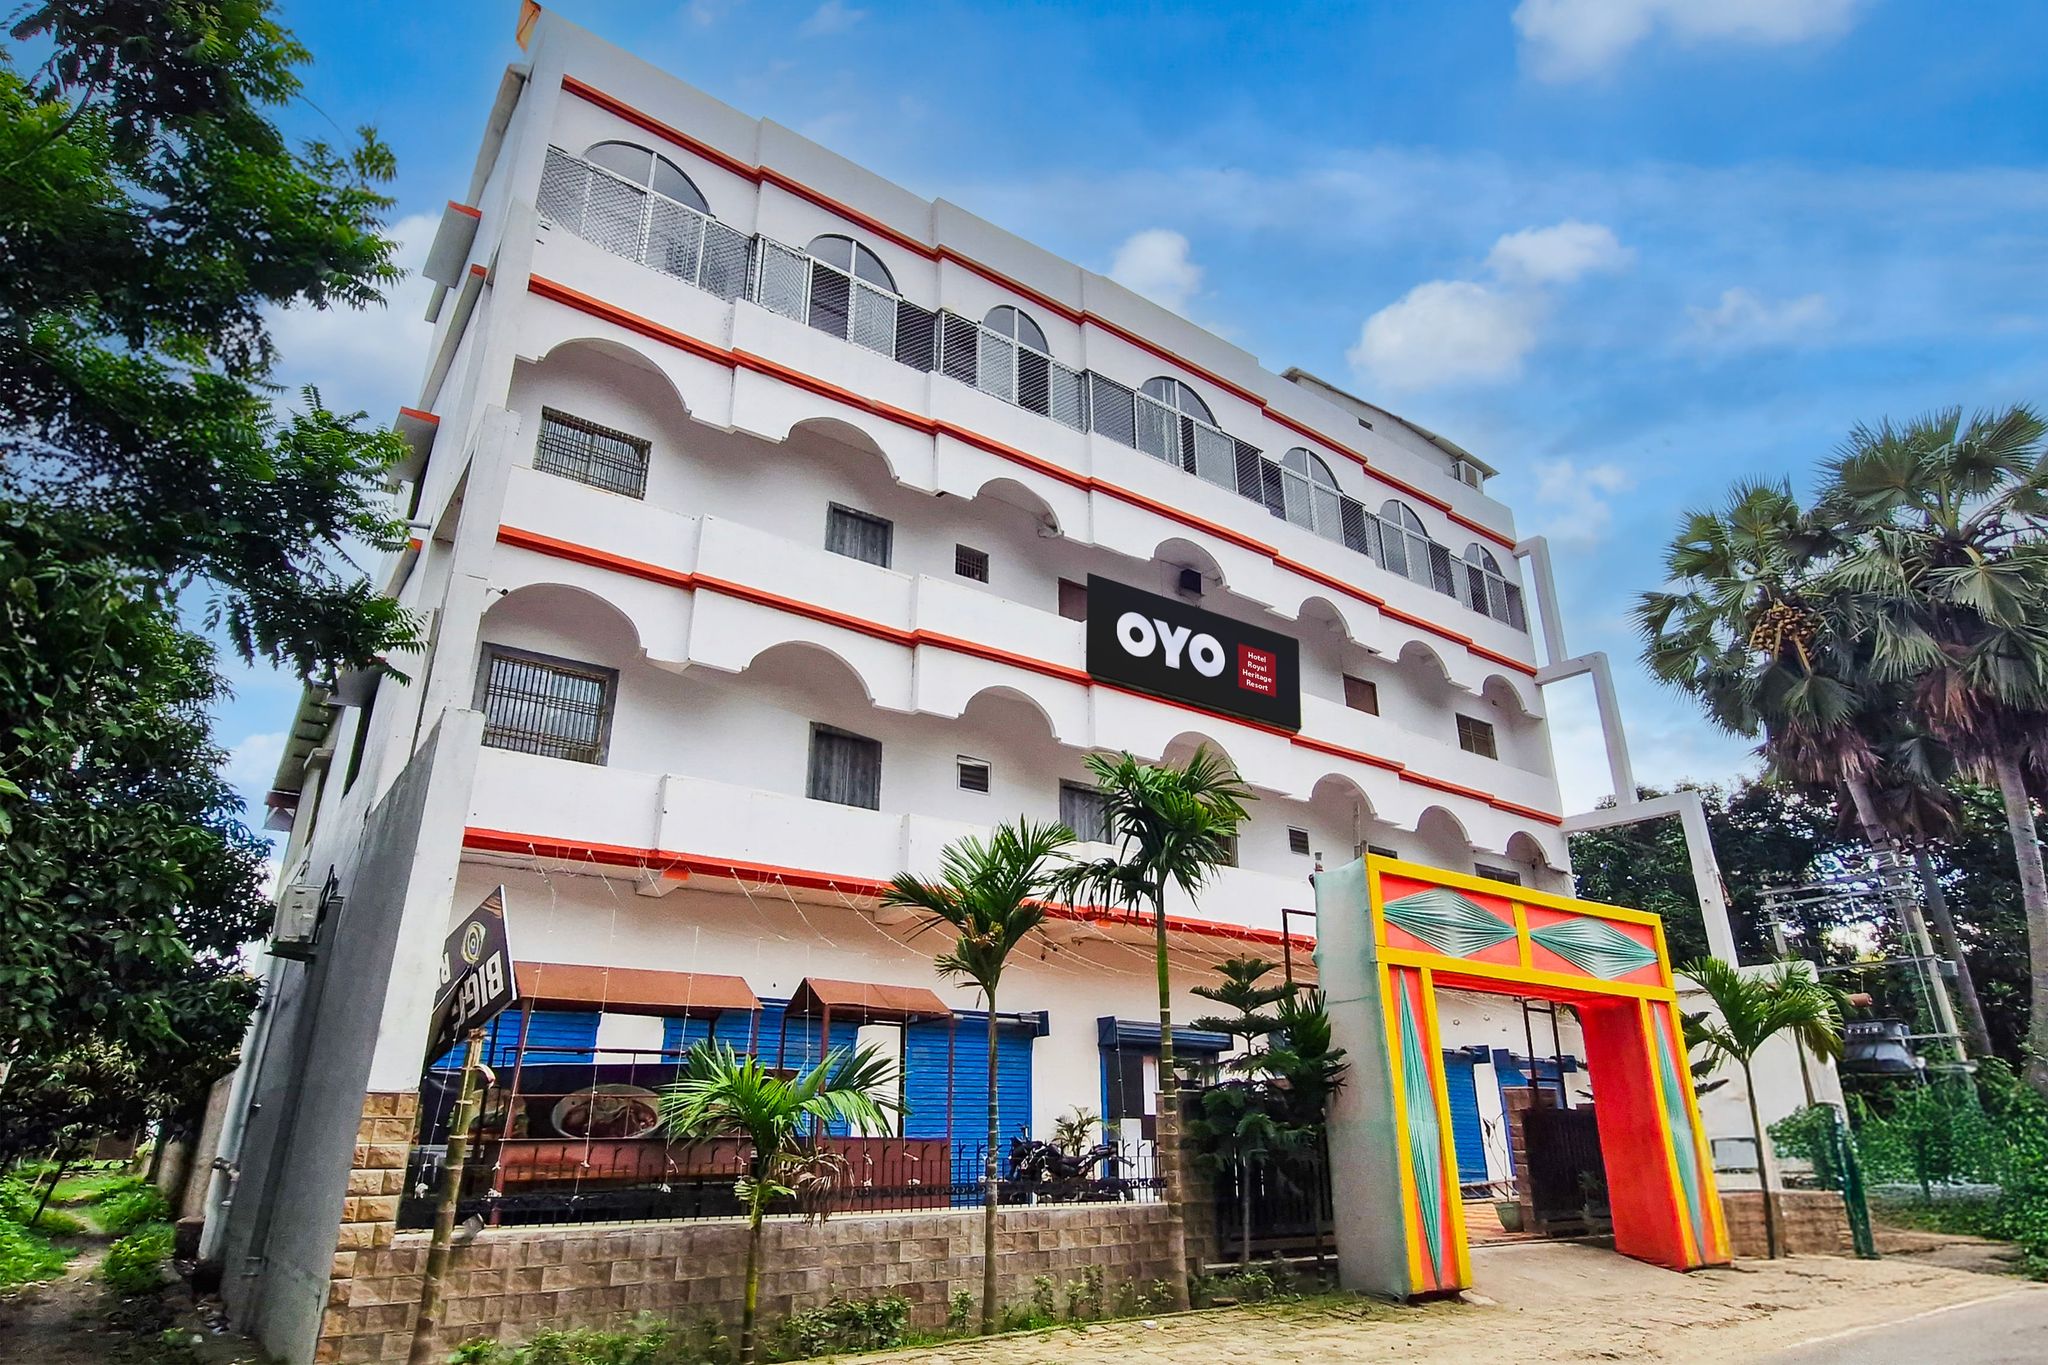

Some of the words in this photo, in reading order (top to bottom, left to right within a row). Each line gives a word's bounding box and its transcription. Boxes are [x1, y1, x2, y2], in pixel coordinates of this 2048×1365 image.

[1116, 611, 1226, 678] OYO
[1247, 651, 1267, 663] Hotel
[1247, 660, 1267, 672] Royal
[1242, 668, 1272, 683] Heritage
[1246, 679, 1268, 691] Resort
